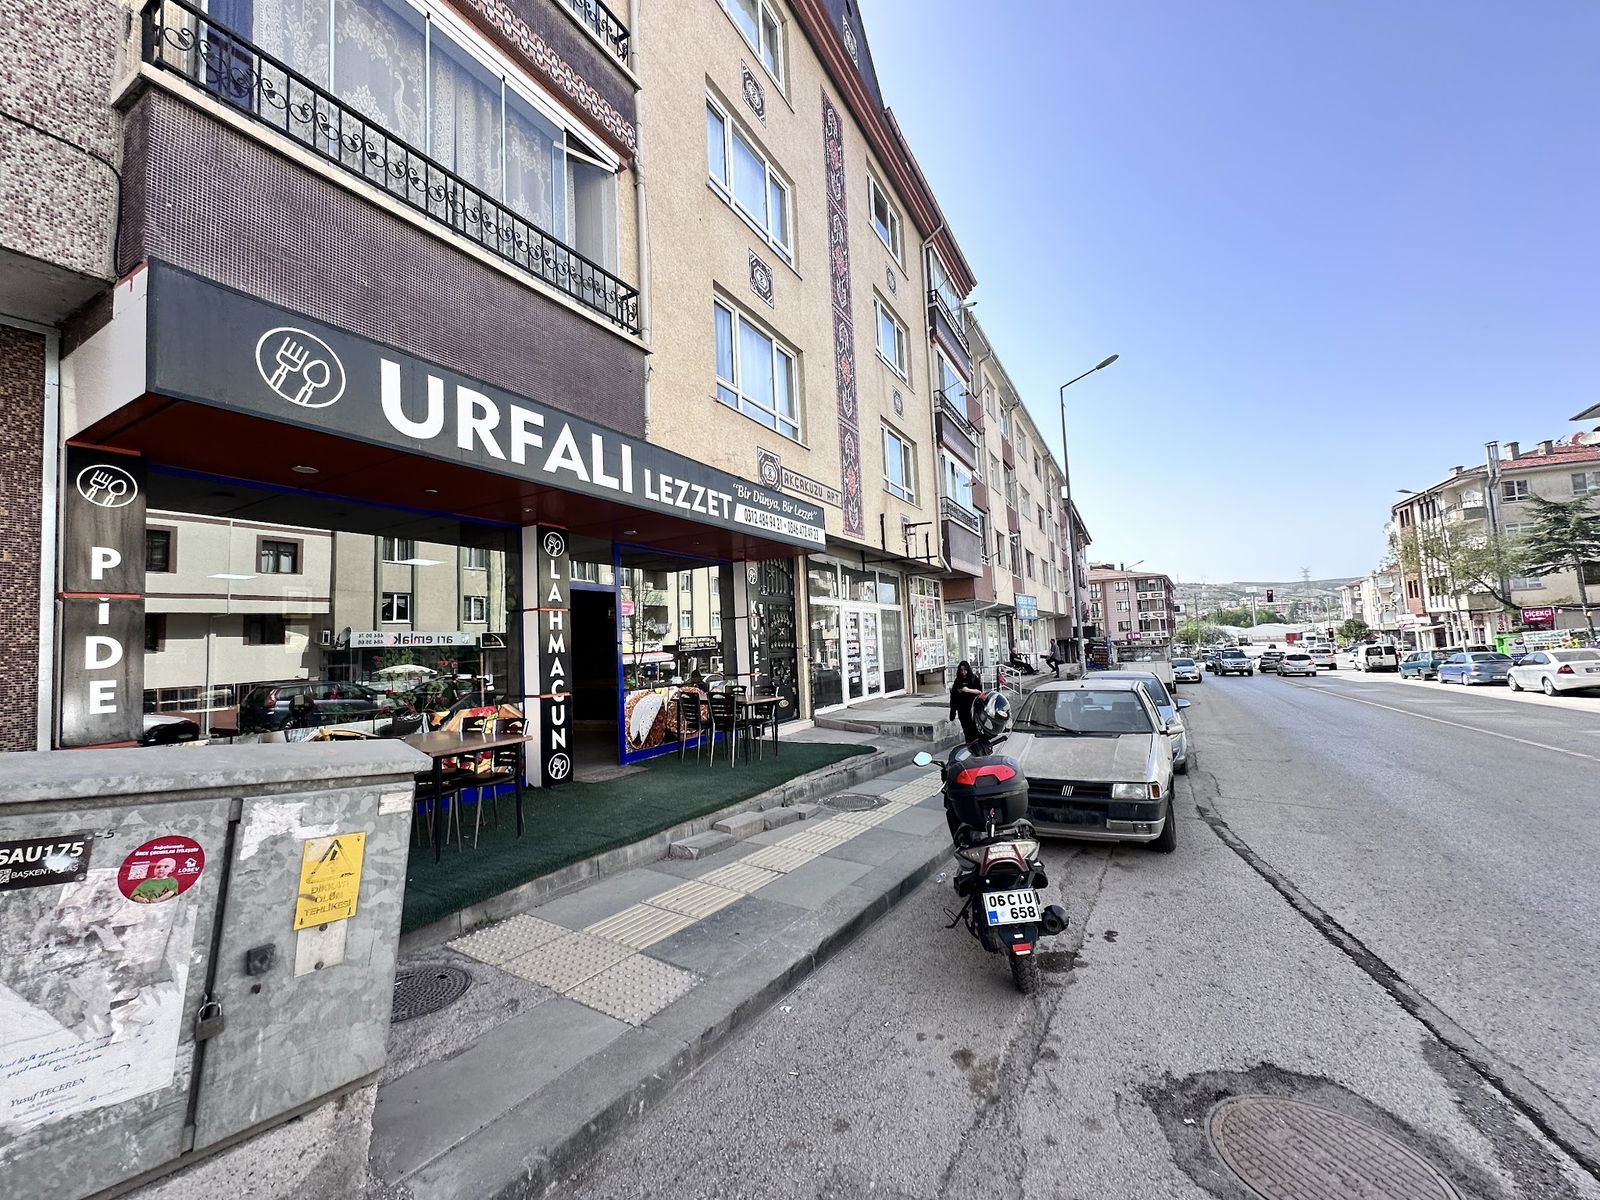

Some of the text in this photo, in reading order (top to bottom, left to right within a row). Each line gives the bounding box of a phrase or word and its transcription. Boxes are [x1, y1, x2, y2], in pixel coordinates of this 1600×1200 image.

[380, 358, 733, 520] URFALI LEZZET
[783, 474, 823, 498] AKÇAKUZU
[782, 500, 794, 514] Bir
[744, 508, 758, 525] 0312
[758, 512, 769, 528] 484
[547, 559, 566, 751] LAHMACUN
[11, 868, 52, 879] BAŞKENT
[989, 892, 1032, 907] 06 CIU
[1010, 906, 1036, 919] 658
[10, 1092, 39, 1107] Yusuf
[40, 1076, 87, 1098] TECEREN
